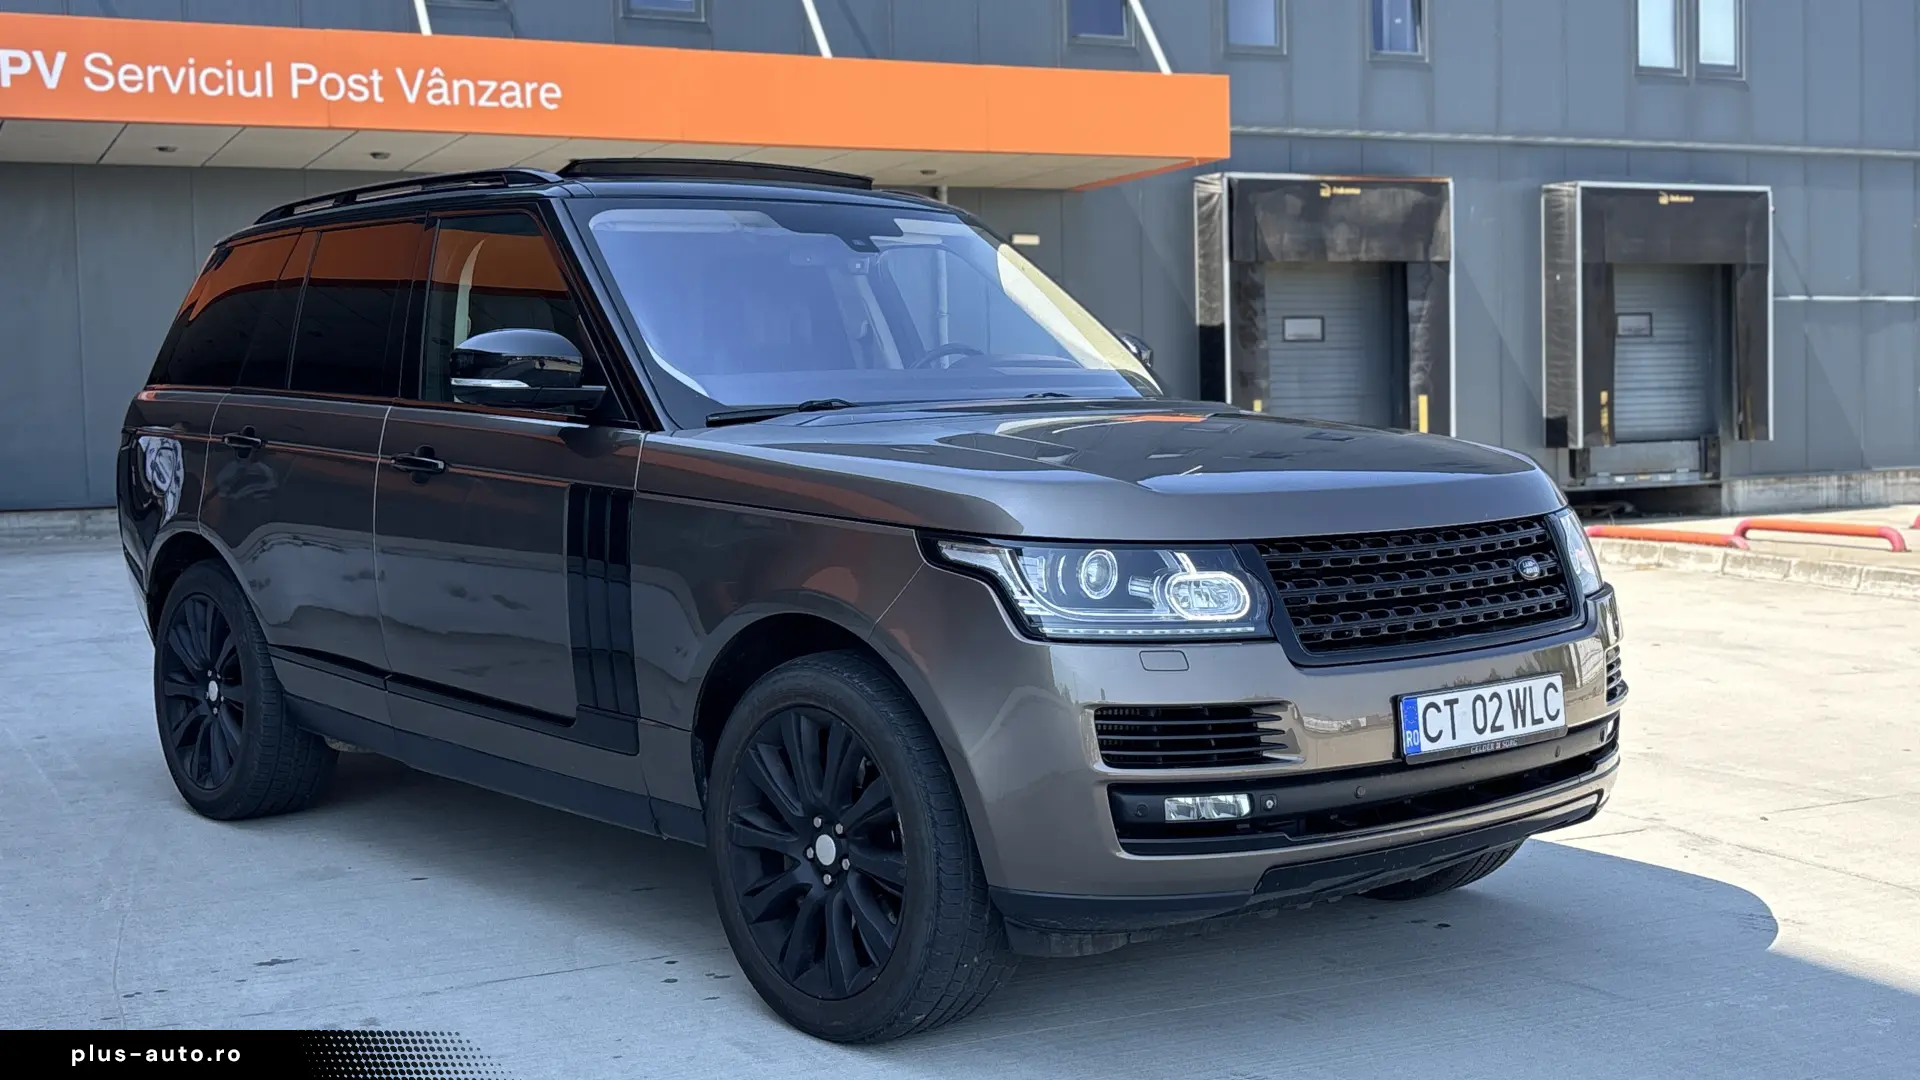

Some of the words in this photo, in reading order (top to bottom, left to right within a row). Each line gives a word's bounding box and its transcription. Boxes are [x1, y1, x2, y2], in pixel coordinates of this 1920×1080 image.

[83, 51, 273, 98] Serviciul
[290, 62, 384, 103] Post
[395, 67, 562, 110] Vânzare
[1406, 729, 1420, 747] RO
[1422, 696, 1460, 743] CT
[1472, 691, 1505, 735] 02
[1507, 681, 1561, 729] WLC
